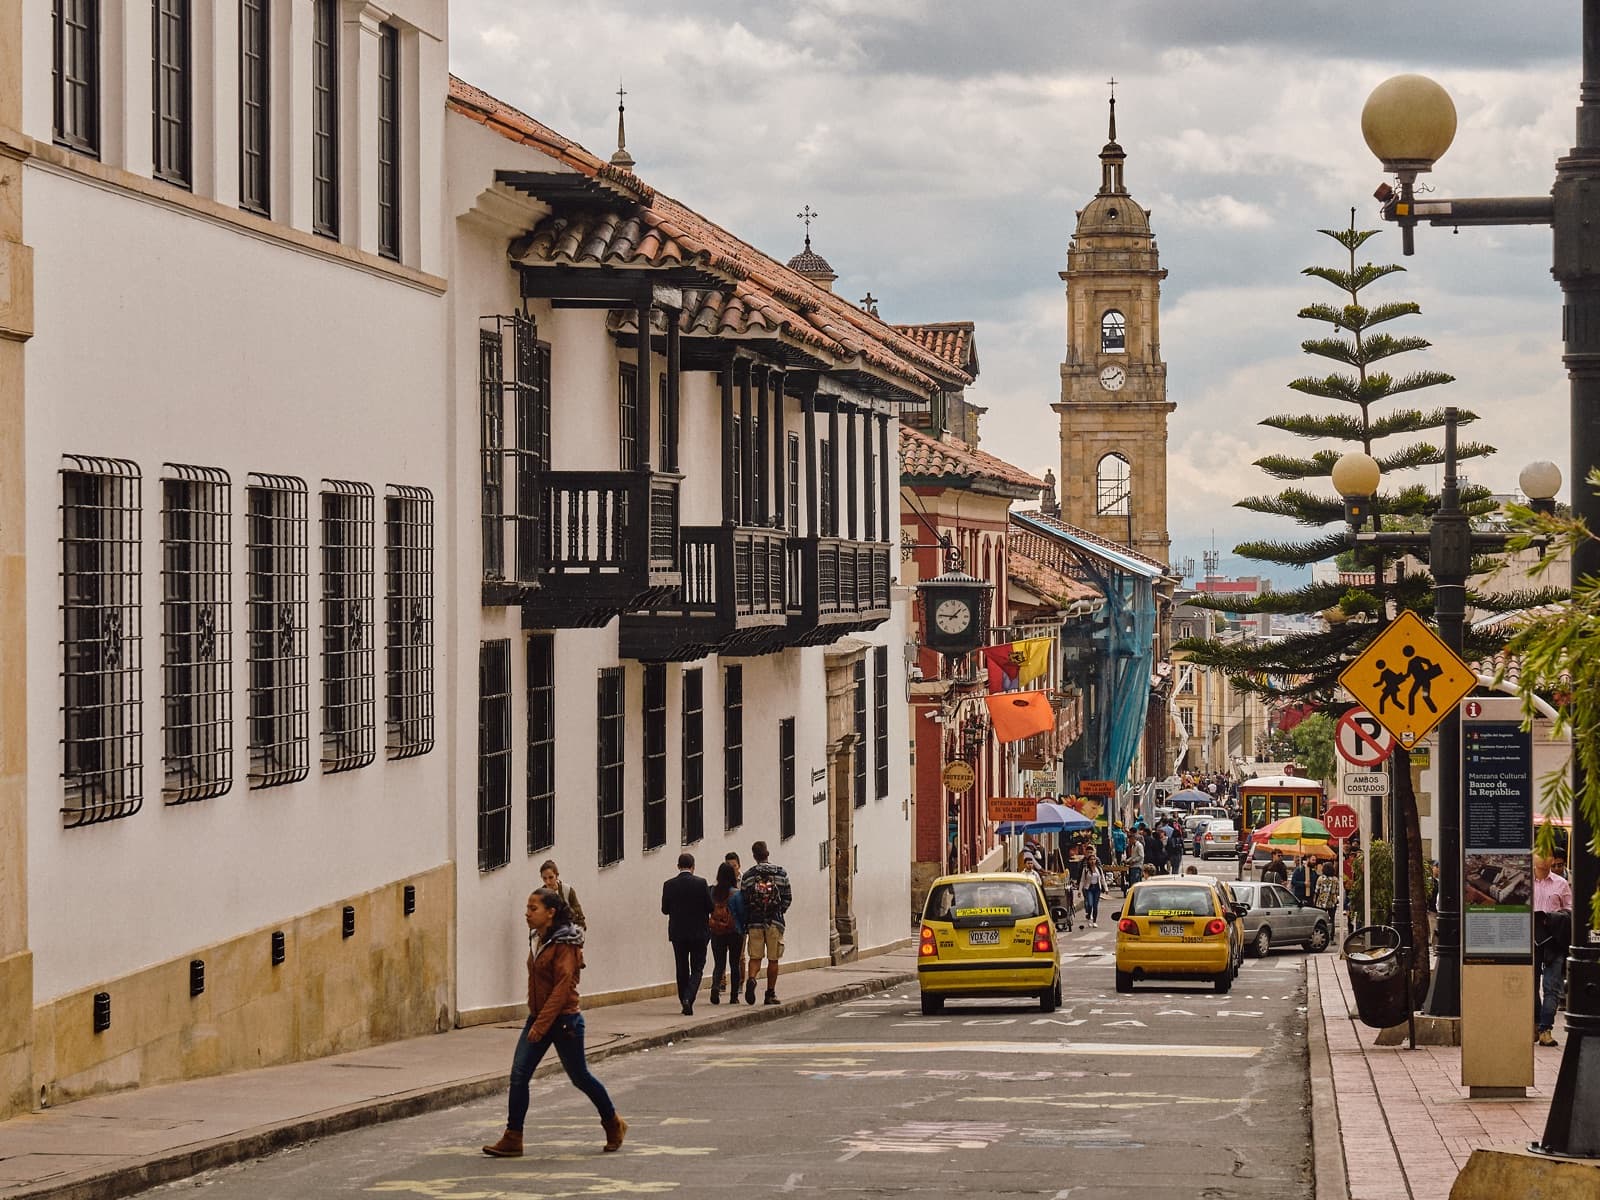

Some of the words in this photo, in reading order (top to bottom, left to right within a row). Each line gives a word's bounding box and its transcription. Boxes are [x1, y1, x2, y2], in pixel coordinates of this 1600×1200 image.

[1354, 717, 1381, 756] P
[1353, 776, 1379, 784] AMBOS
[1496, 780, 1507, 788] de
[1347, 784, 1385, 792] COSTADOS
[1469, 788, 1477, 796] la
[1479, 788, 1521, 797] República
[1327, 815, 1354, 828] PARE
[889, 1018, 1149, 1028] ZONA
